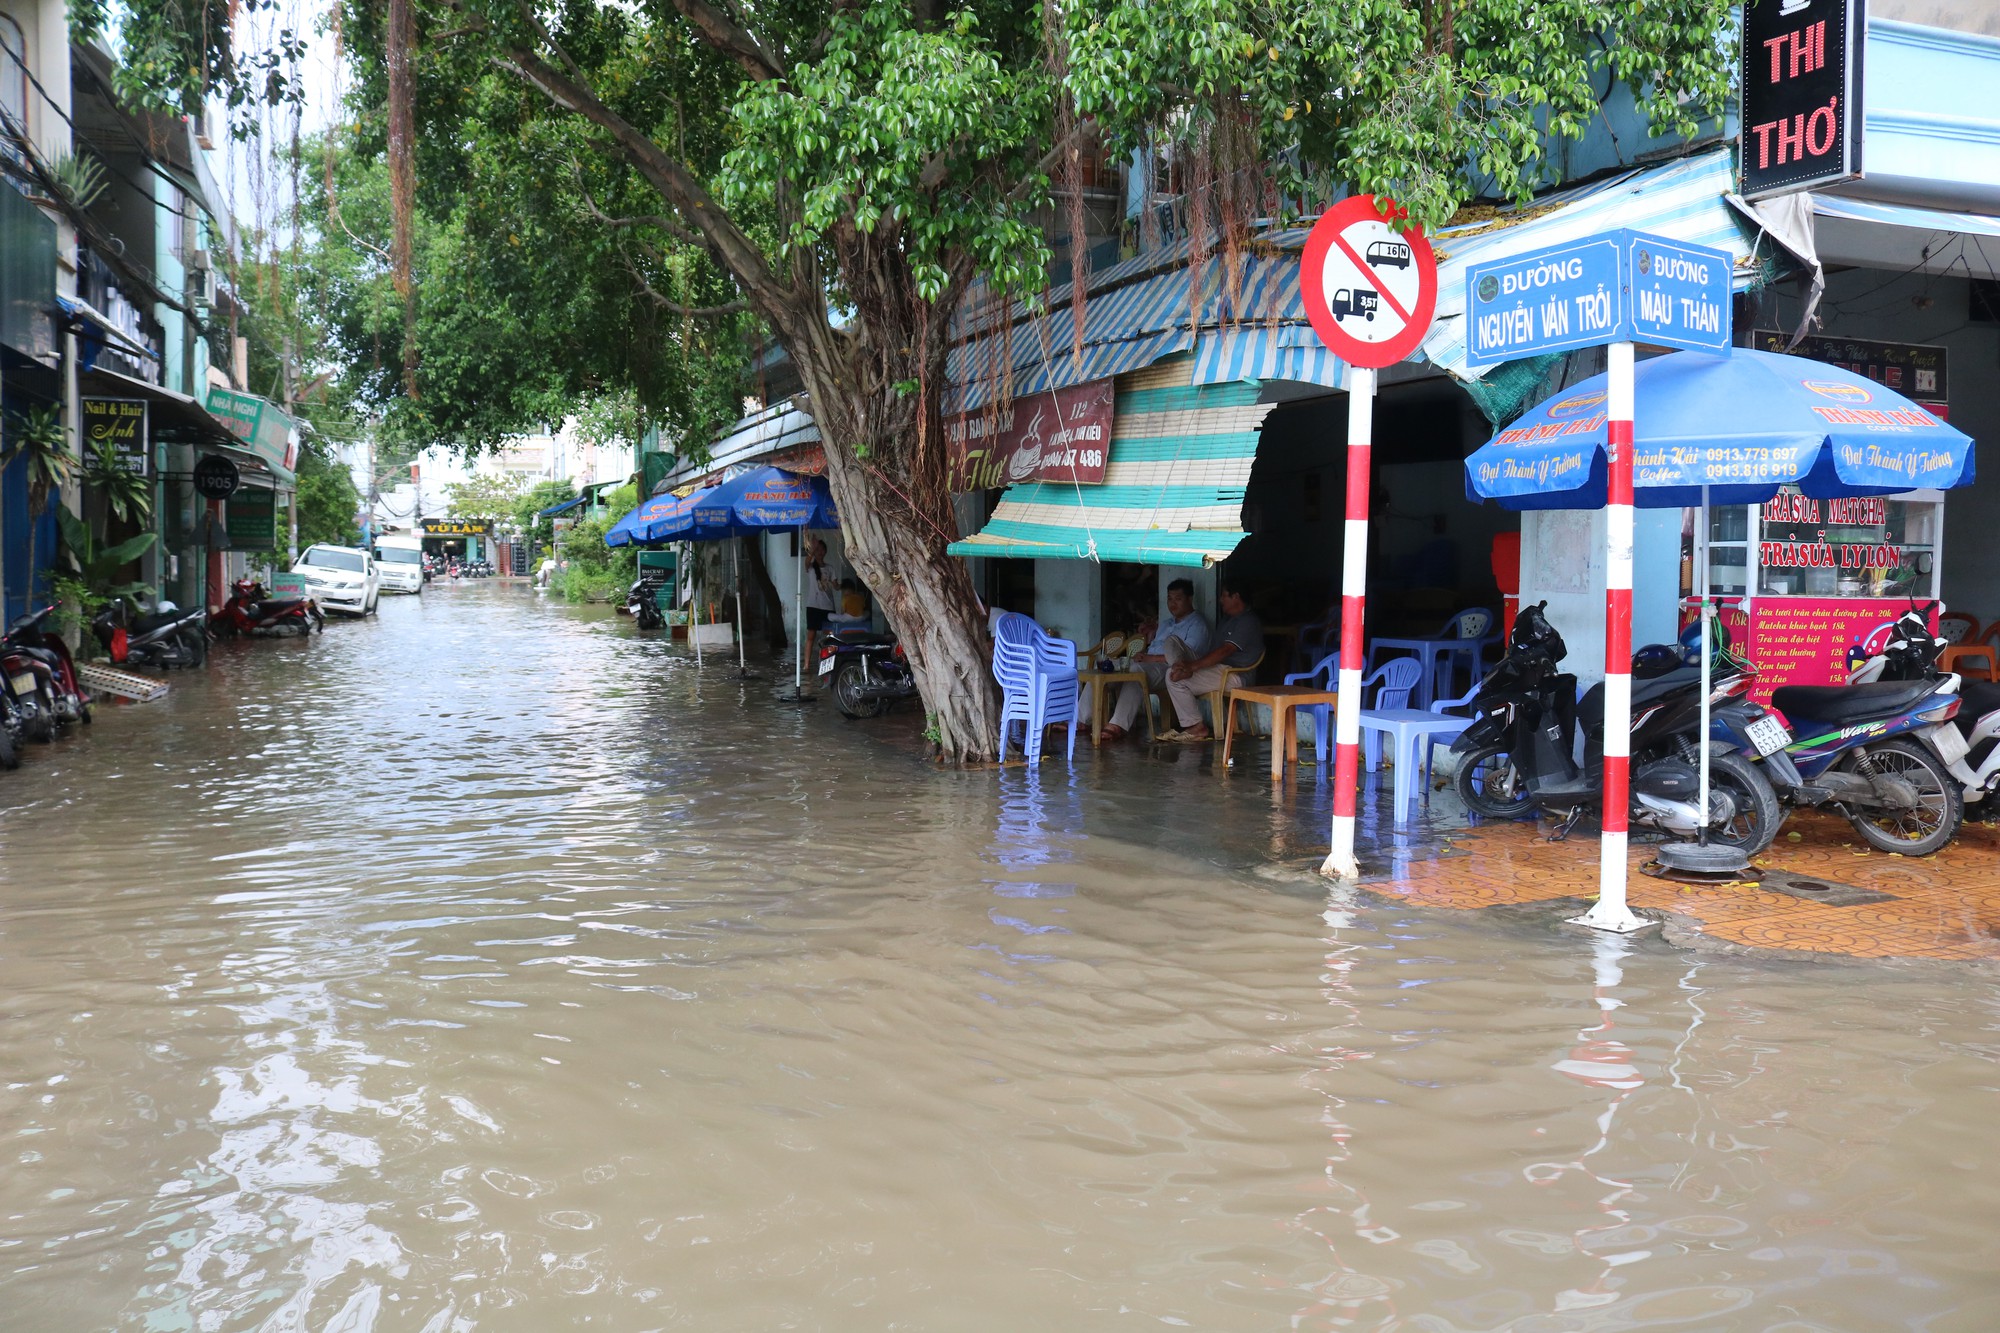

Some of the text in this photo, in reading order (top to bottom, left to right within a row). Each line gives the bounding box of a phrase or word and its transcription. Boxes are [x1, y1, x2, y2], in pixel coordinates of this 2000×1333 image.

[1763, 19, 1826, 84] THI
[1752, 95, 1838, 170] THƠ
[1387, 246, 1407, 257] 16 N
[1502, 258, 1583, 295] ĐƯỜNG
[1654, 253, 1709, 285] ĐƯỜNG
[1640, 283, 1719, 333] MẬU THÂN
[1478, 283, 1611, 350] NGUYỄN VĂN TRỖI
[85, 401, 143, 416] Nail & Hair
[1080, 450, 1102, 468] 486
[1633, 446, 1666, 466] hành
[1706, 447, 1769, 461] 0913.779
[1773, 447, 1798, 461] 697
[1706, 463, 1769, 477] 0913.816
[1771, 463, 1798, 477] 919
[201, 476, 232, 489] 1905
[1828, 497, 1886, 526] MATCHA
[1730, 611, 1747, 626] 18k
[1878, 608, 1892, 618] 20k
[1756, 621, 1787, 630] Matcha
[1832, 621, 1846, 630] 18k
[1831, 635, 1845, 643] 18k
[1830, 648, 1844, 656] 12k
[1829, 661, 1843, 670] 18k
[1829, 674, 1843, 683] 15k
[1840, 723, 1886, 740] Wave
